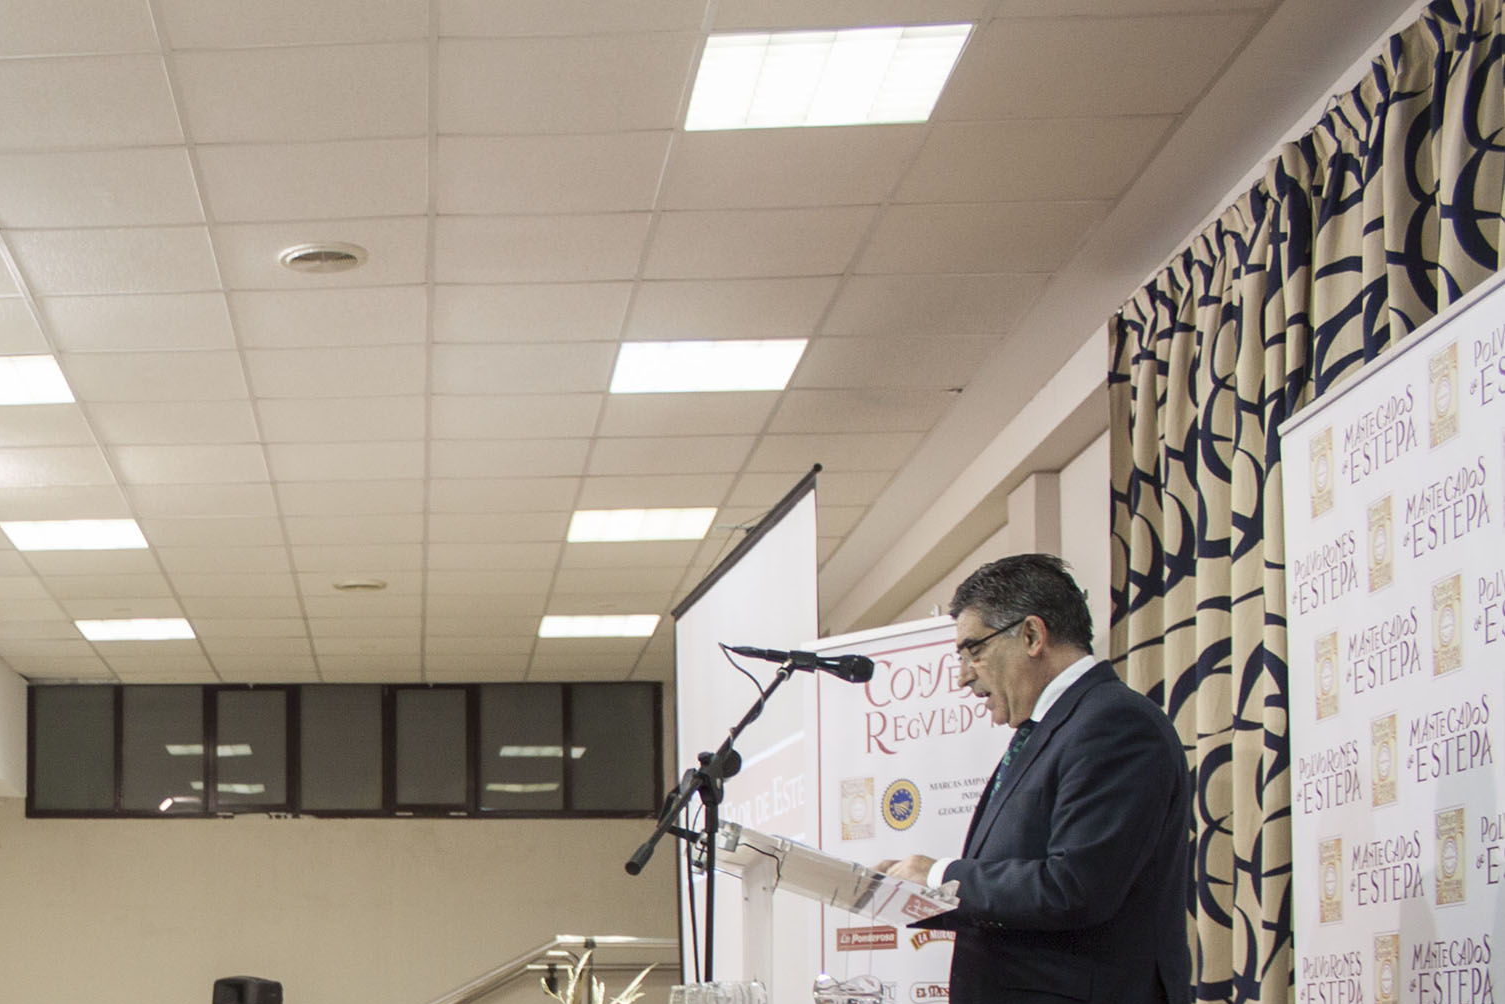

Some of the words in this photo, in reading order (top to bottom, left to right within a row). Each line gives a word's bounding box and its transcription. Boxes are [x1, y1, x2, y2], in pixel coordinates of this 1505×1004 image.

[1344, 384, 1413, 453] MANTECADOS
[1350, 415, 1418, 485] ESTEPA
[1406, 456, 1486, 524] MANTECADOS
[1412, 490, 1490, 559] ESTEPA
[1299, 558, 1358, 615] ESTEPA
[1348, 606, 1418, 661] MANTECADOS
[865, 654, 970, 707] CONSE
[1354, 638, 1421, 694] ESTEPA
[1409, 694, 1489, 746] MANTECADOS
[1416, 728, 1493, 783] ESTEPA
[1303, 768, 1362, 814] ESTEPA
[1352, 830, 1421, 871] MANTECADOS
[1358, 863, 1424, 906] ESTEPA
[1412, 934, 1491, 970] MANTECADOS
